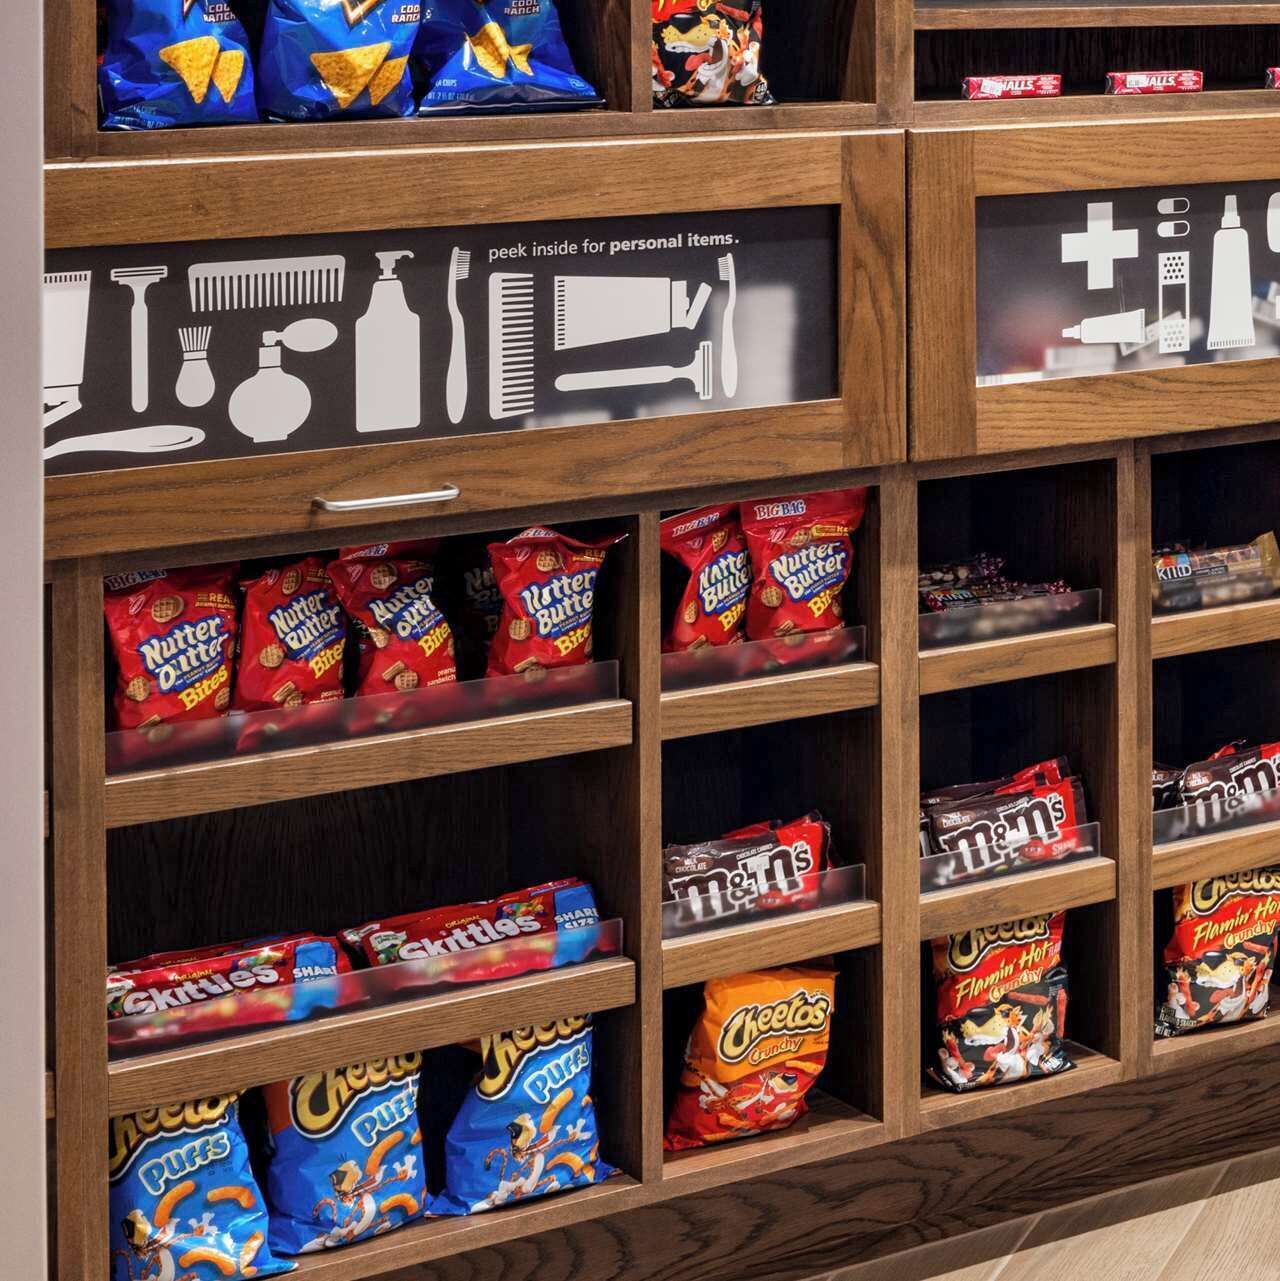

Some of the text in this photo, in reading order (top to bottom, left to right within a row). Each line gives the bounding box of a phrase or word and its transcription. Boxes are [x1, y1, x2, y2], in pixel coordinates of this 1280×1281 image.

[504, 6, 541, 17] RANCH
[488, 231, 740, 264] peek inside for personal items.
[770, 542, 841, 583] Nutter
[783, 551, 848, 600] Butter
[1156, 563, 1194, 581] KIND
[270, 590, 326, 639] Nutter
[370, 576, 434, 626] Nutter
[522, 570, 597, 614] Nutter
[139, 615, 222, 672] Nutter
[285, 605, 341, 652] Butter
[179, 663, 229, 711] Bites
[667, 840, 815, 926] m&m's
[675, 862, 708, 874] CHOCOLATE
[399, 914, 543, 962] Skittles
[1194, 909, 1254, 950] Flamin'
[1224, 918, 1277, 949] Crunchy
[121, 963, 281, 1020] Skittles
[955, 940, 1050, 1009] Flamin' Hot
[989, 966, 1043, 1003] Crunchy
[722, 991, 830, 1060] Cheetos
[750, 1035, 804, 1065] Crunchy
[526, 1044, 591, 1106] PUFFS
[141, 1131, 230, 1195] PUFFS
